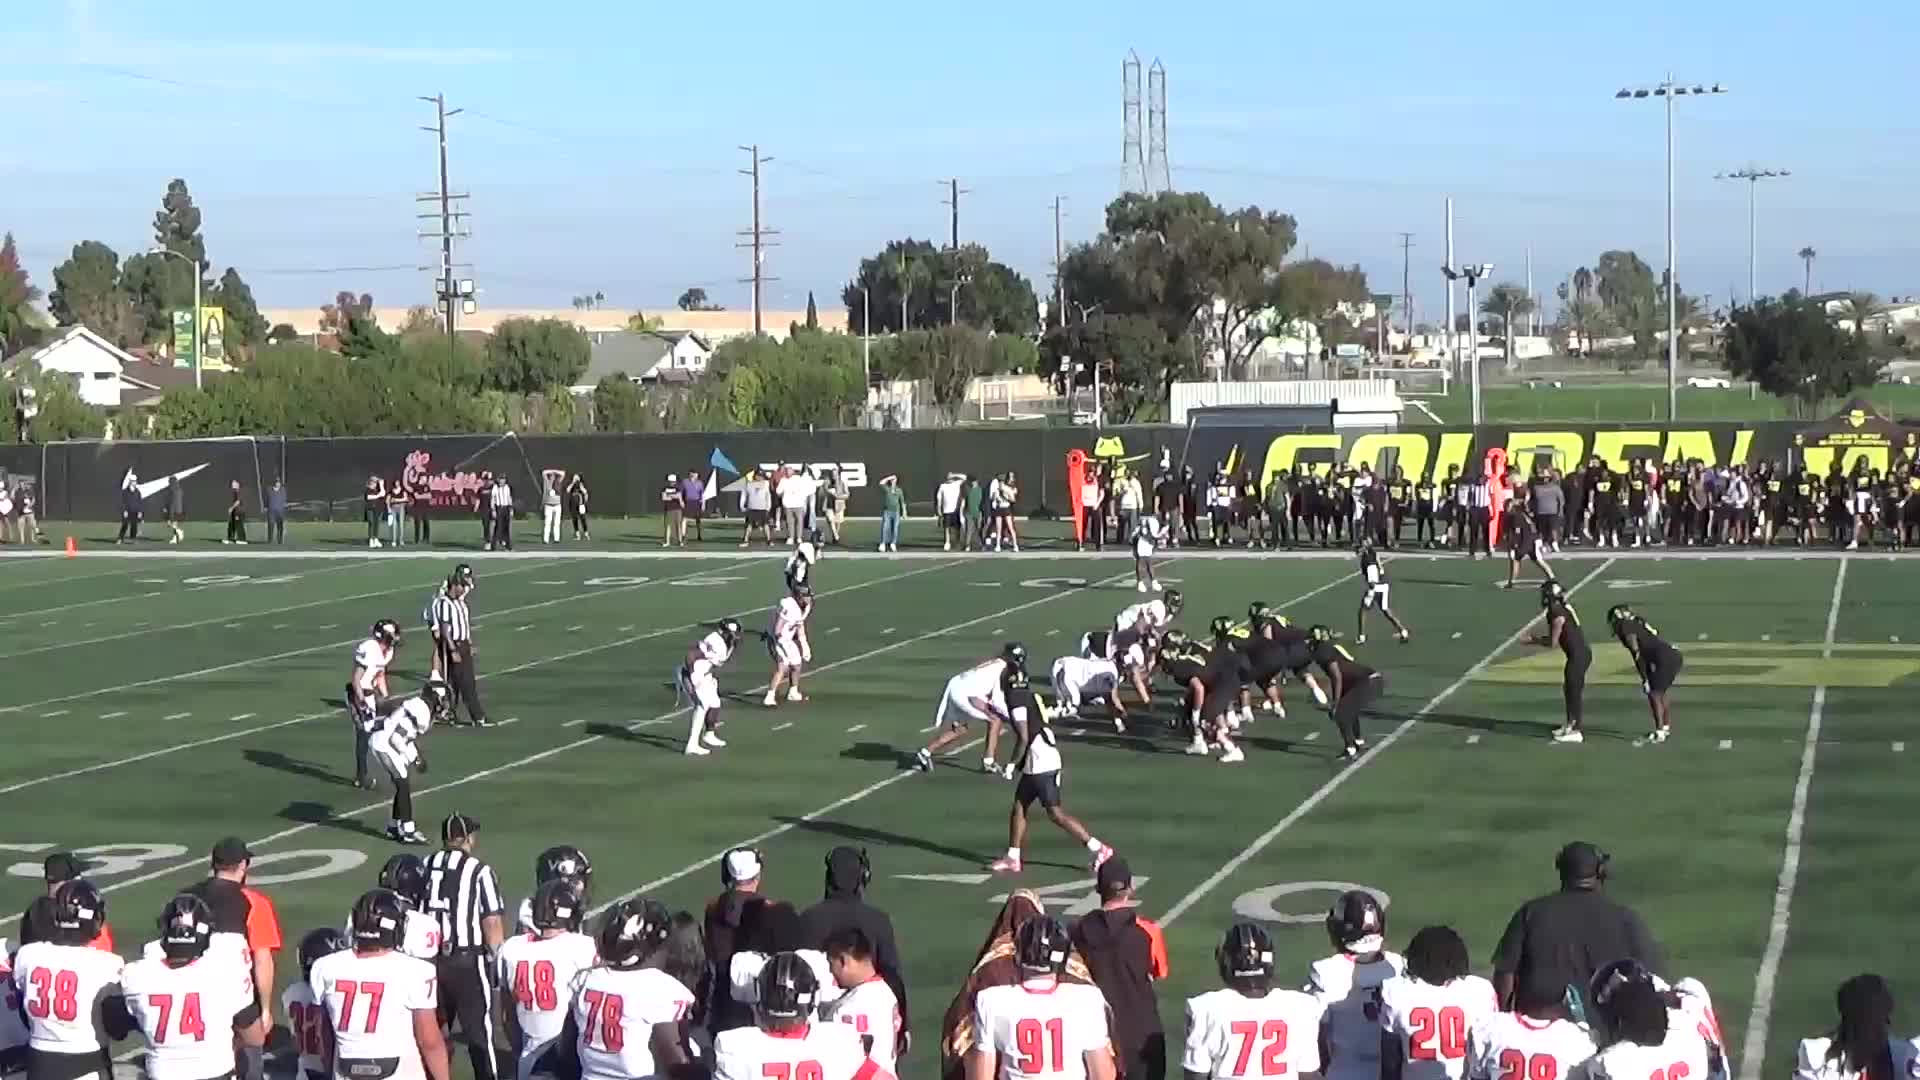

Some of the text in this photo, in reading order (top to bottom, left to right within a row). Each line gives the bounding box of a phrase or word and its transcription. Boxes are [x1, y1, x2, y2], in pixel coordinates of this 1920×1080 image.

[28, 966, 78, 1021] 38
[335, 980, 384, 1033] 77
[514, 960, 557, 1012] 48
[148, 992, 205, 1044] 74
[582, 989, 624, 1054] 78
[1016, 1017, 1064, 1074] 91
[1409, 1006, 1465, 1061] 20
[1230, 1019, 1287, 1076] 72
